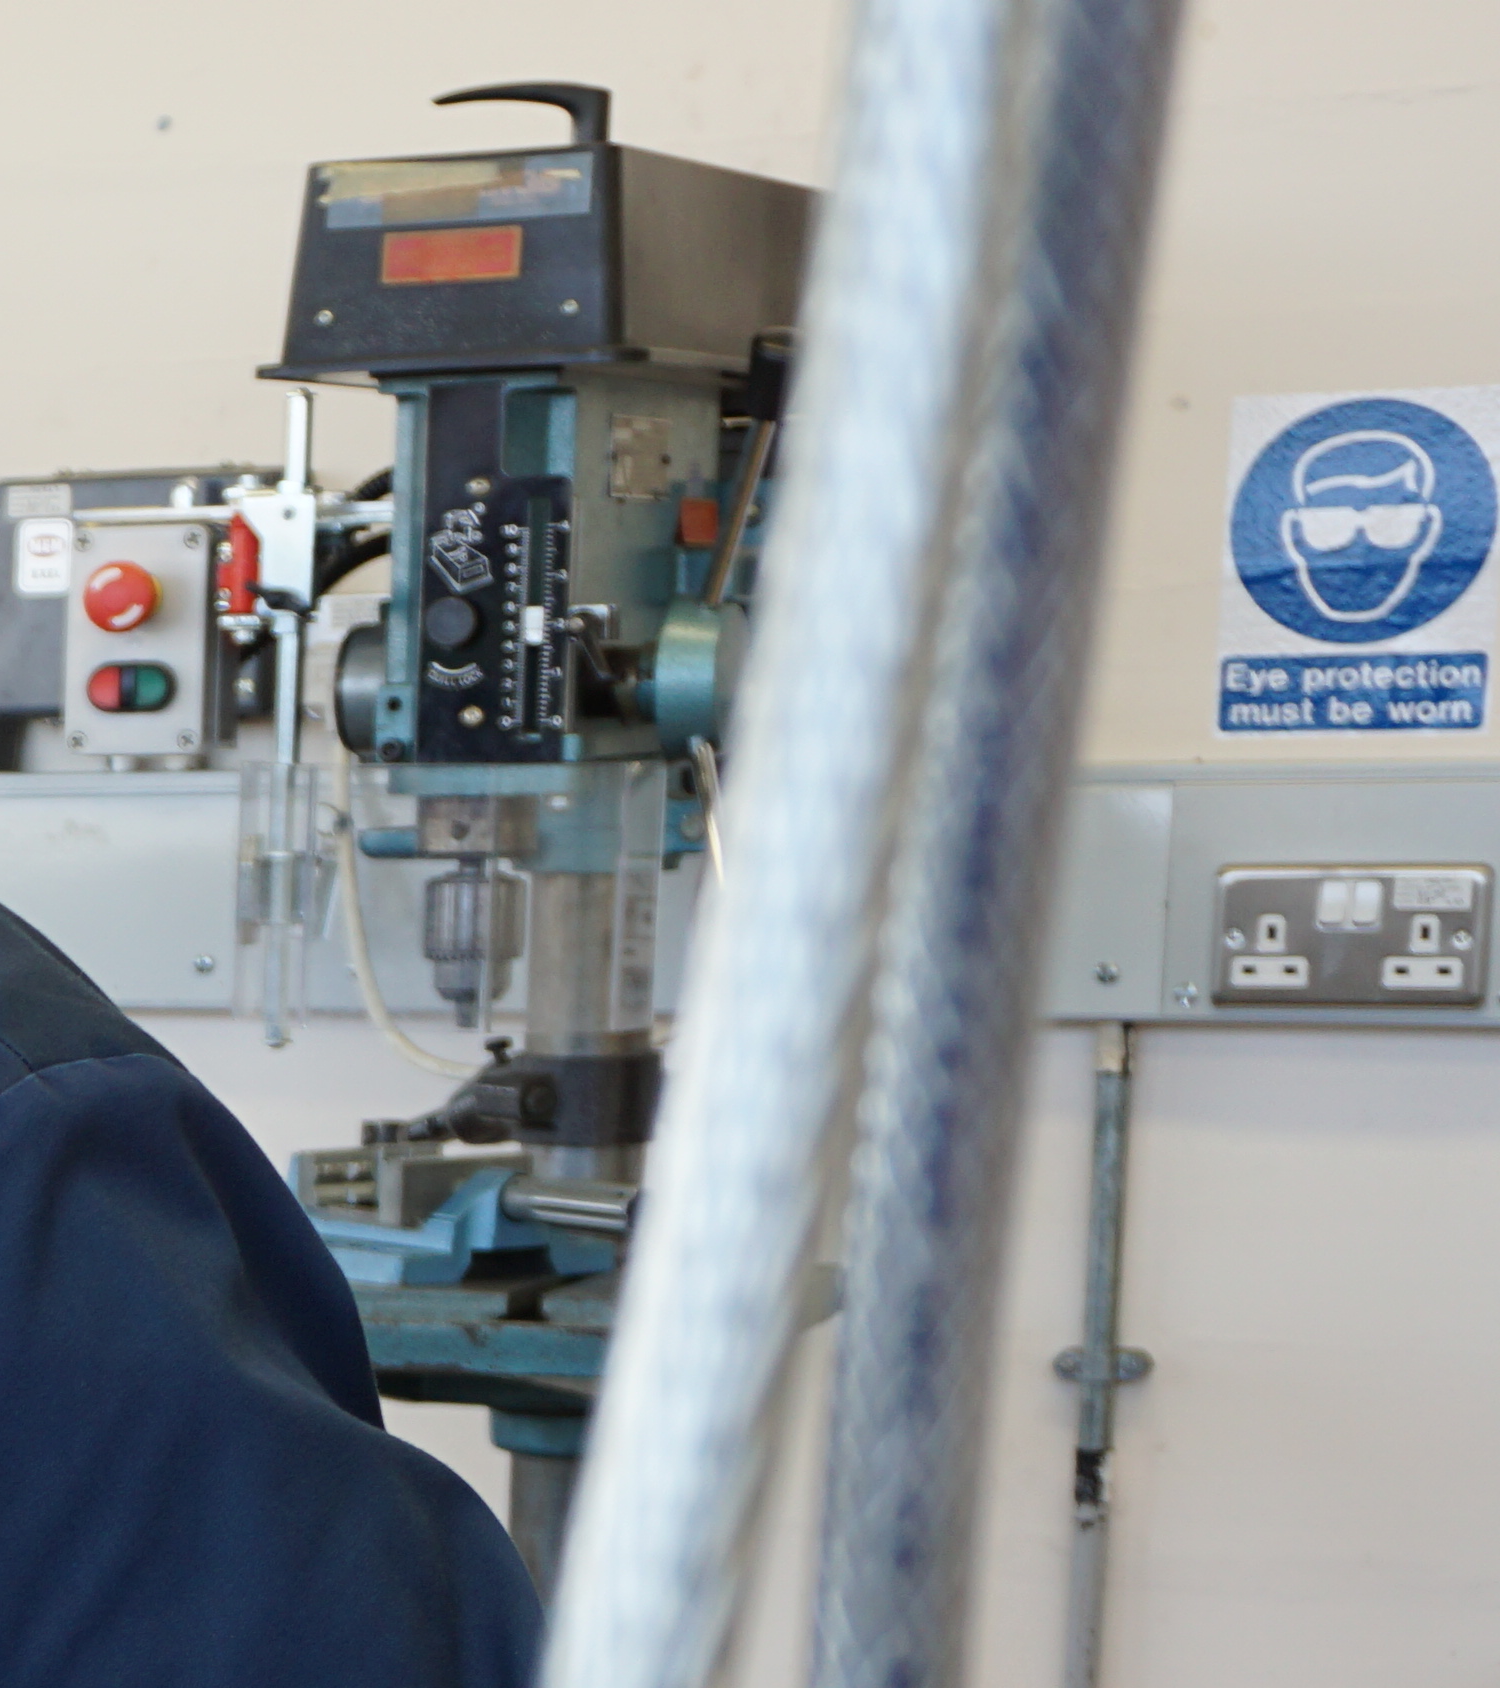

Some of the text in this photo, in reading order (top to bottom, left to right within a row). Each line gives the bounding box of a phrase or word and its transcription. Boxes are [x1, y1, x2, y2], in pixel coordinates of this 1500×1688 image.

[1225, 659, 1482, 695] Eye protection
[1228, 696, 1473, 726] must be worn
